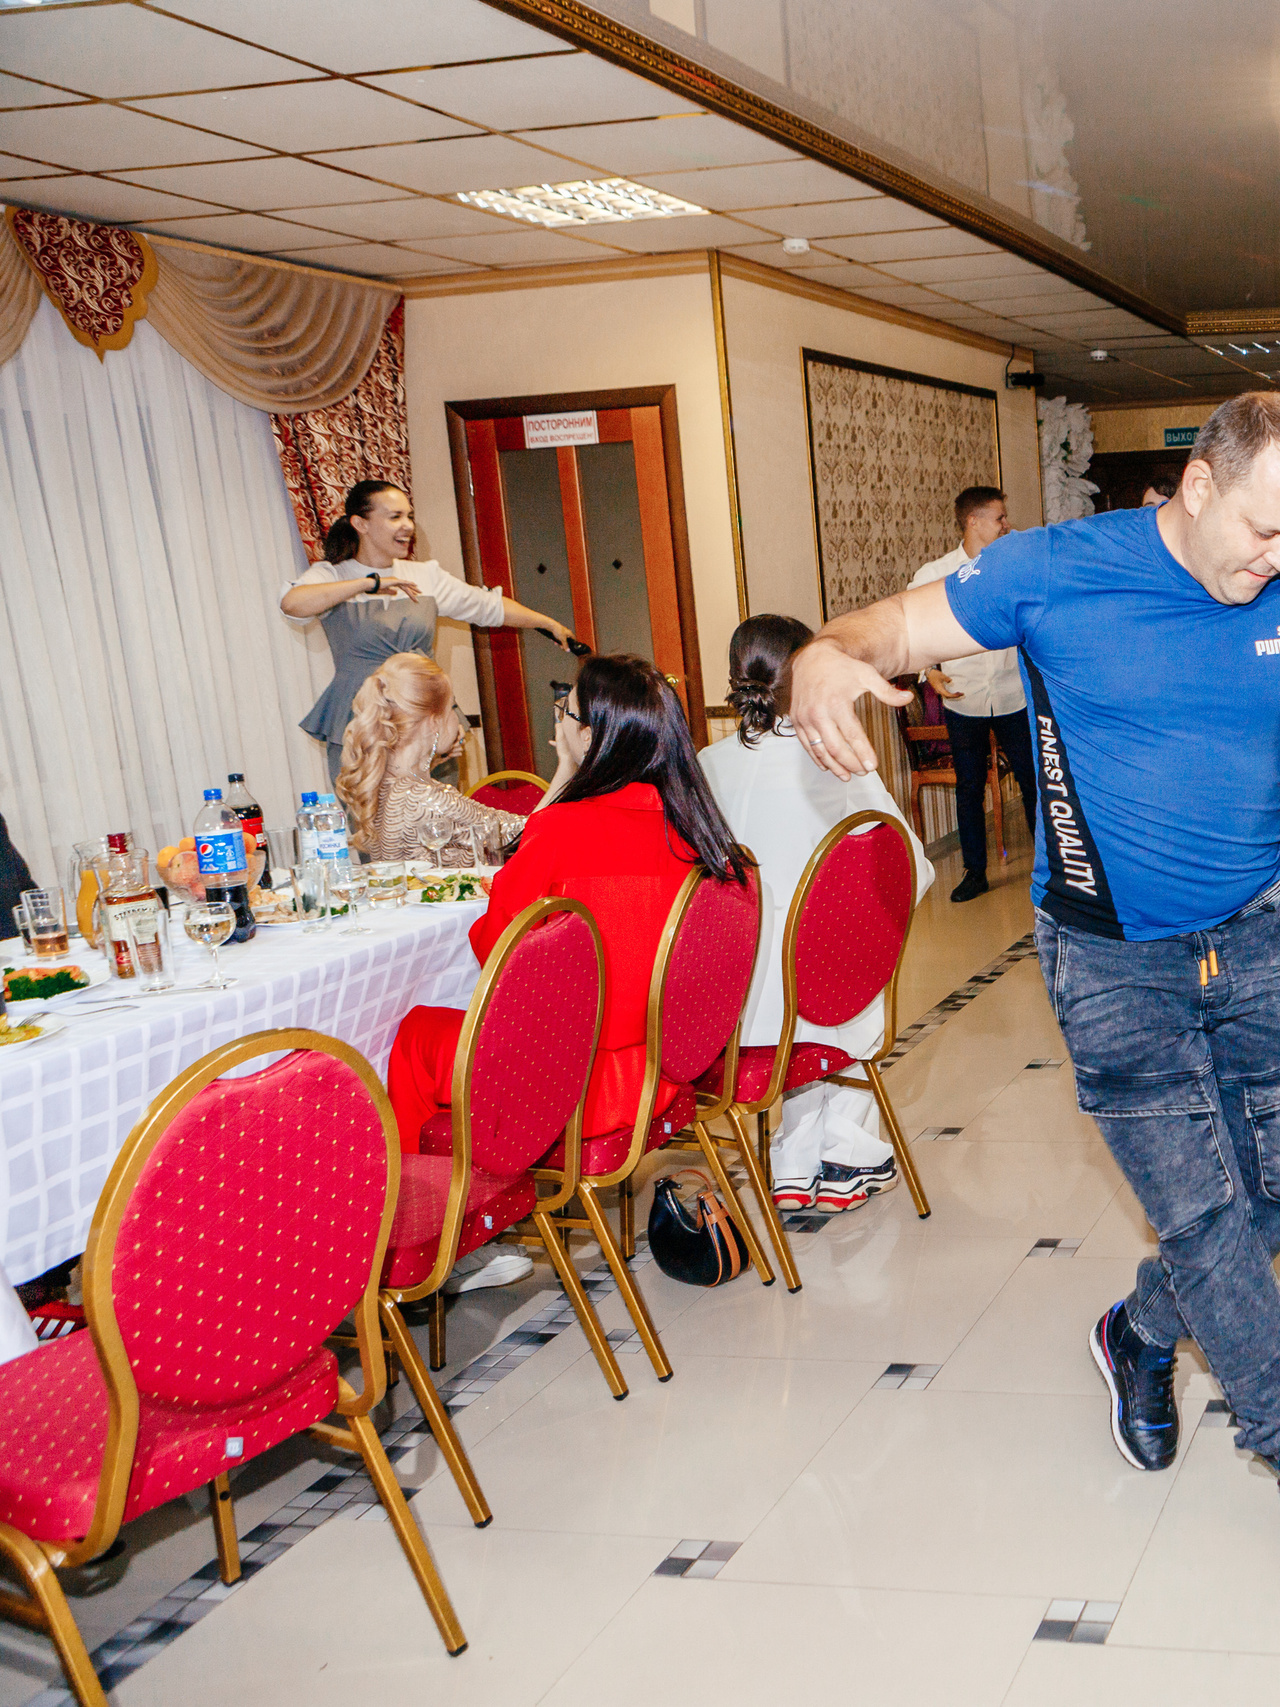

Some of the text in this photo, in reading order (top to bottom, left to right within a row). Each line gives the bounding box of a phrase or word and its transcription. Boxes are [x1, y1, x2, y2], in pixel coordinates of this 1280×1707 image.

[528, 416, 592, 431] ПОСТОРОННИМ
[530, 435, 549, 443] ВХОД
[1037, 715, 1098, 896] FINEST QUALITY
